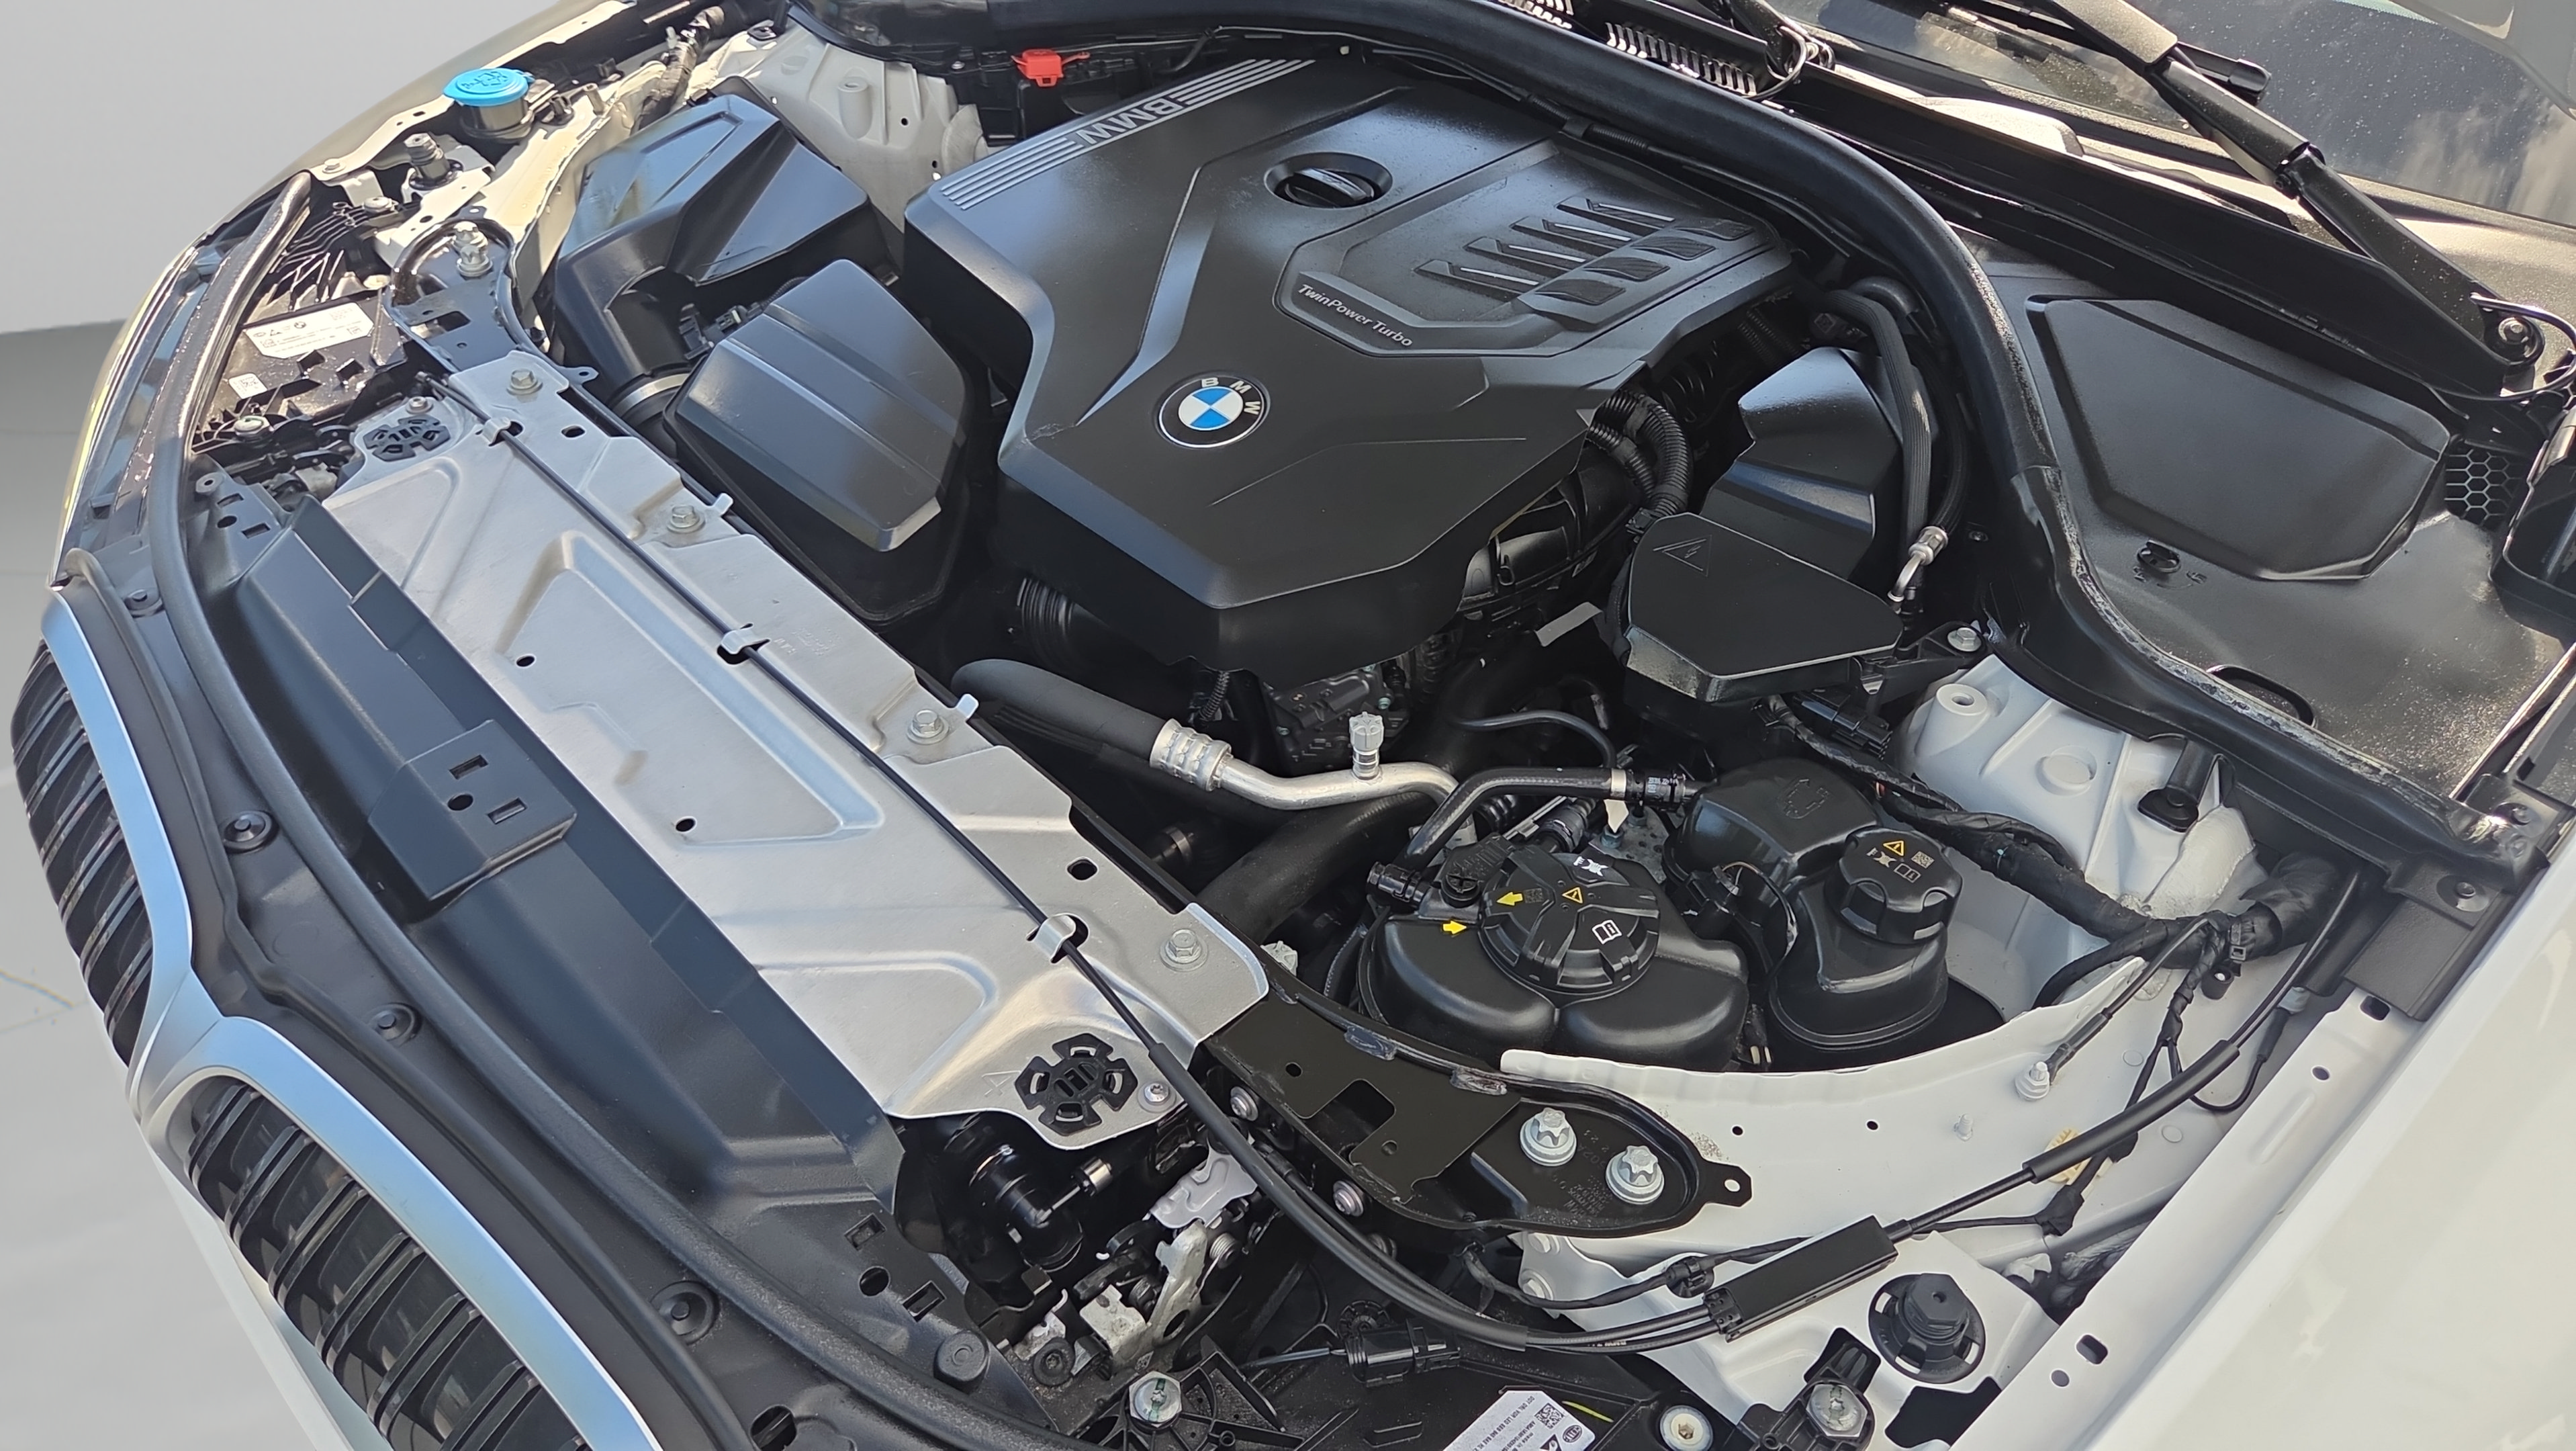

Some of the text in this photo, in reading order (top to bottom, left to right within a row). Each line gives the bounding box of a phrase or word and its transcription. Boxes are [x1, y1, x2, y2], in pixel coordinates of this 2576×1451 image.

[1076, 98, 1184, 144] BMW
[1298, 284, 1413, 347] TwinPower Turbo
[1201, 377, 1261, 415] BMW
[1503, 1416, 1513, 1425] LED
[1522, 1432, 1534, 1444] made
